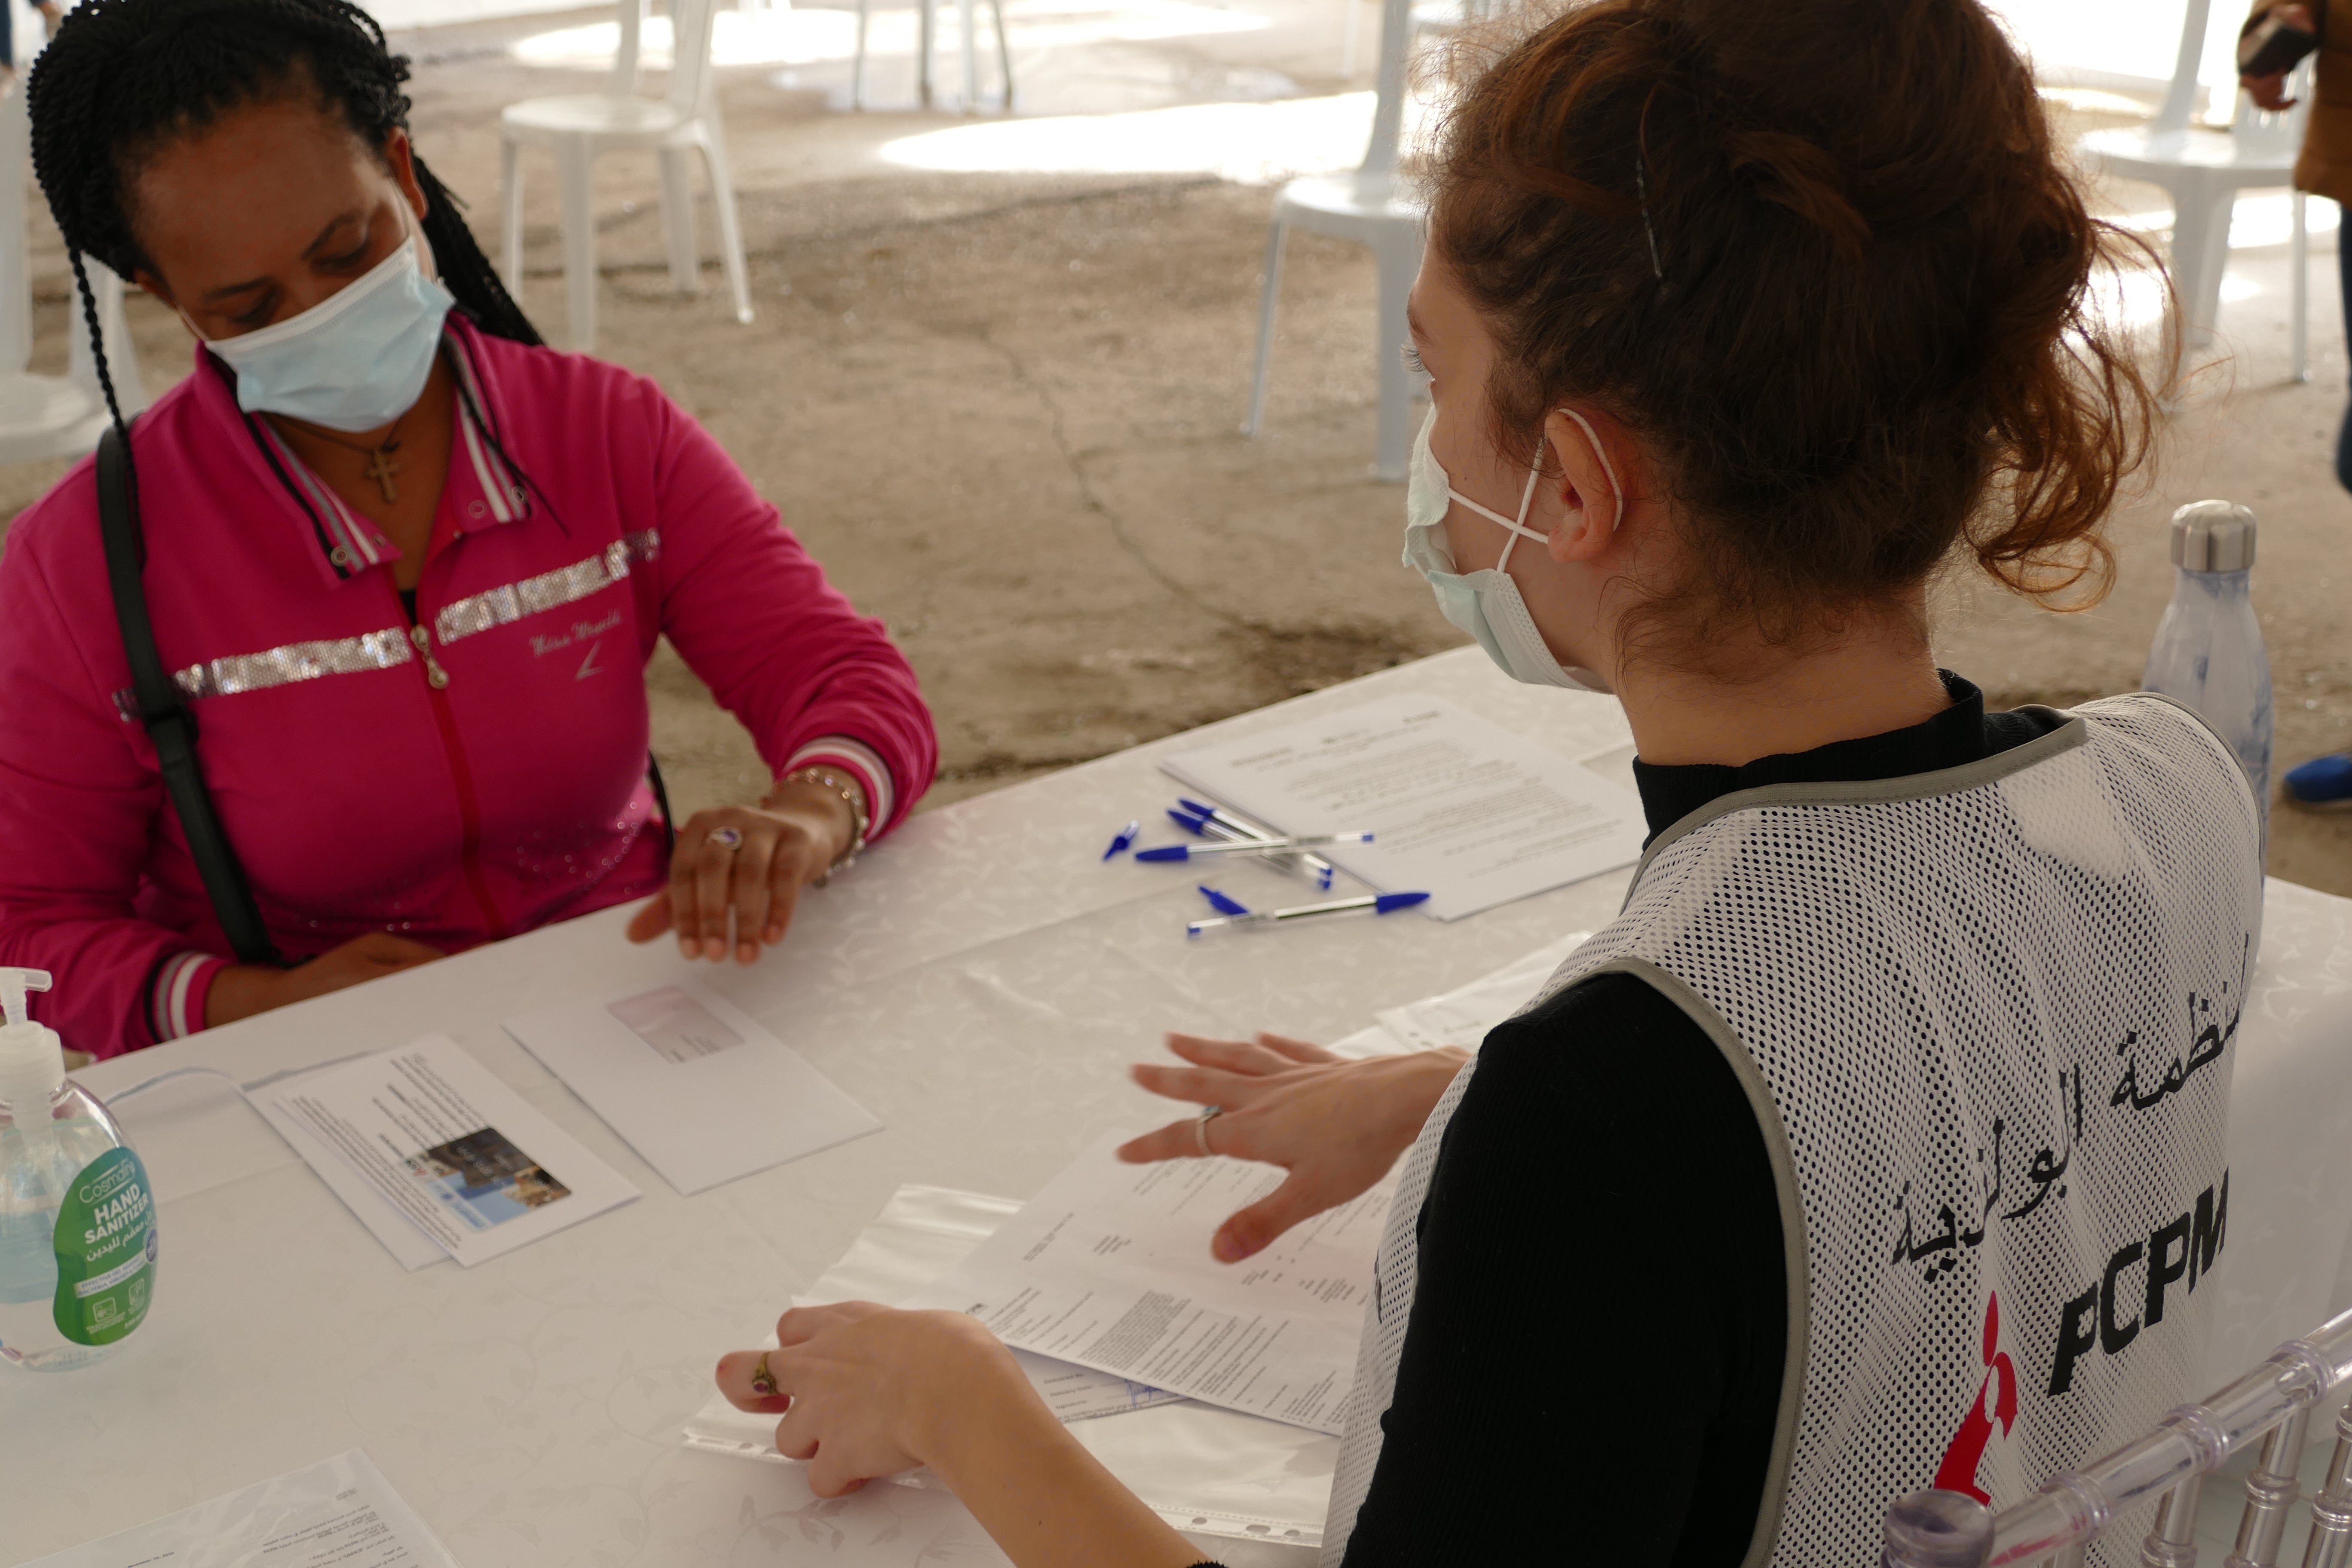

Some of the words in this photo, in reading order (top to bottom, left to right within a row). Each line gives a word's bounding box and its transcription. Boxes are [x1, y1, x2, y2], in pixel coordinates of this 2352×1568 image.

[85, 1192, 149, 1244] SANITIZER
[94, 1183, 140, 1225] HAND
[2047, 1164, 2229, 1398] PCPM
